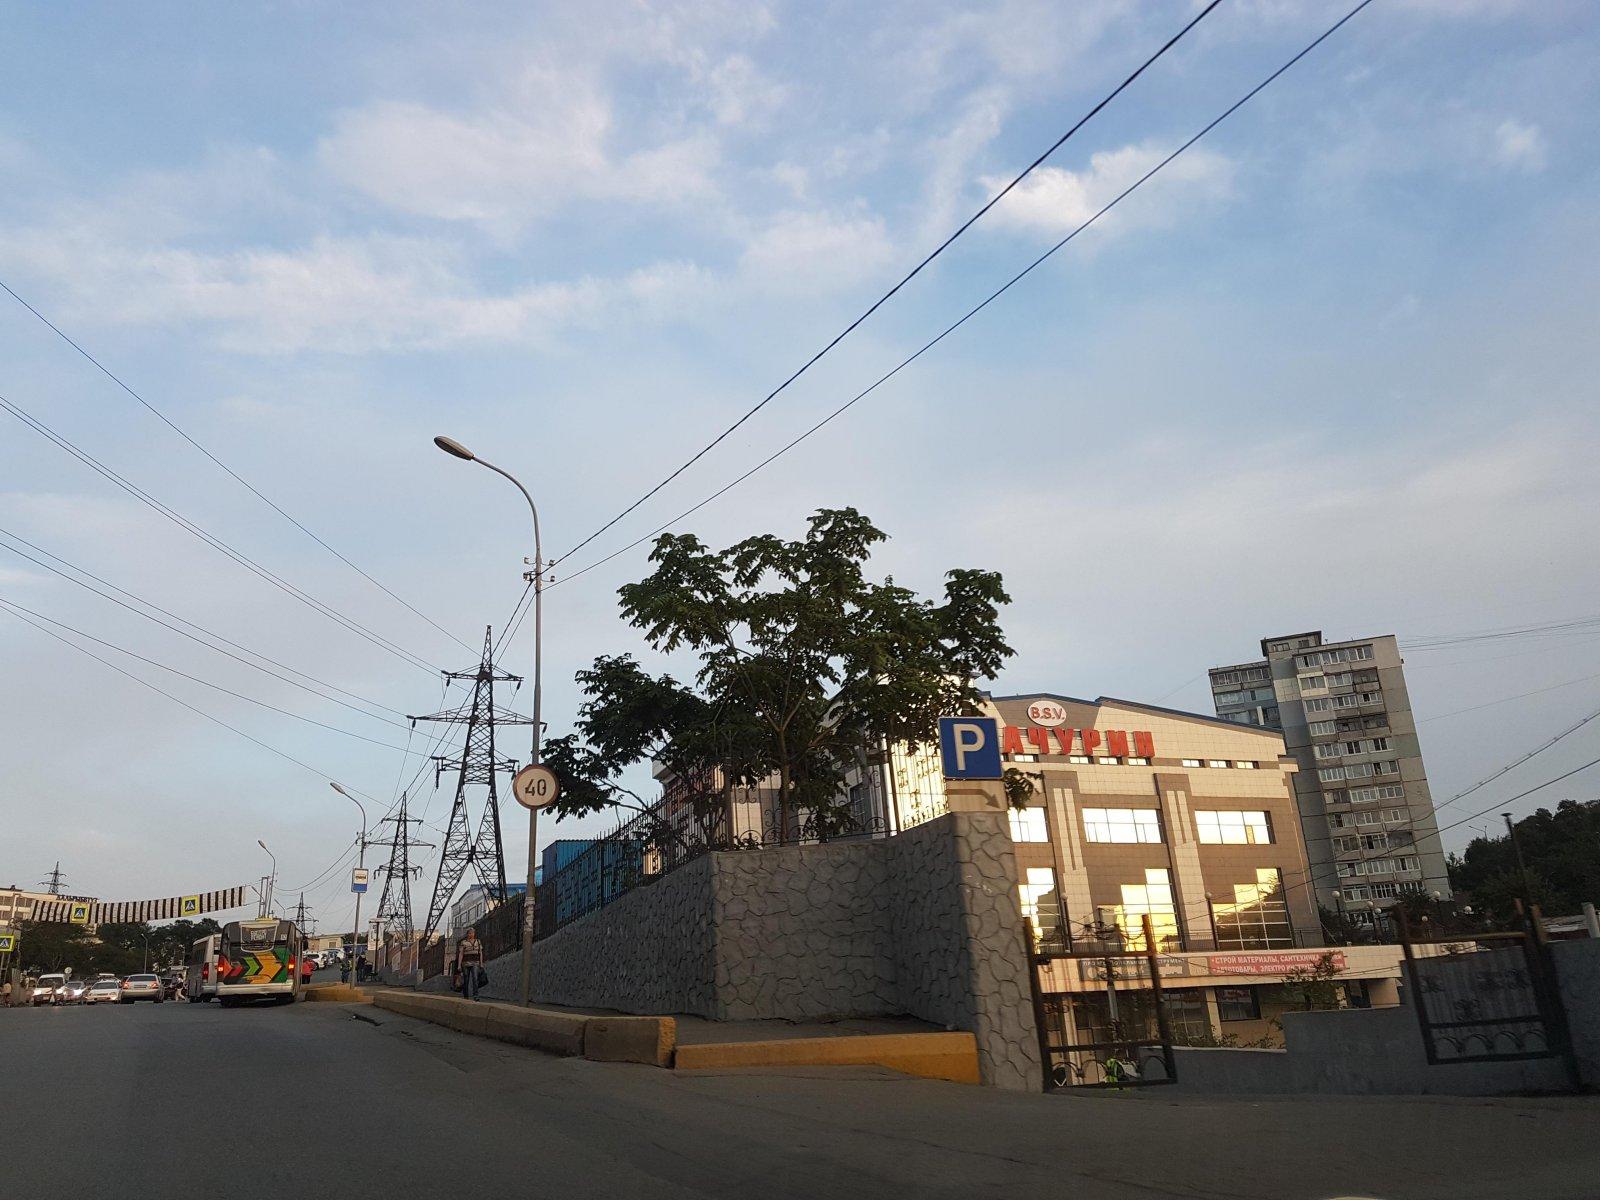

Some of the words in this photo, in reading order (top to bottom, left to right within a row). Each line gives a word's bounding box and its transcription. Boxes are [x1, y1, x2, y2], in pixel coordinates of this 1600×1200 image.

[1030, 706, 1066, 721] B.S.V.
[953, 724, 986, 771] P
[525, 778, 547, 797] 40
[1215, 955, 1237, 964] СТРОЙ
